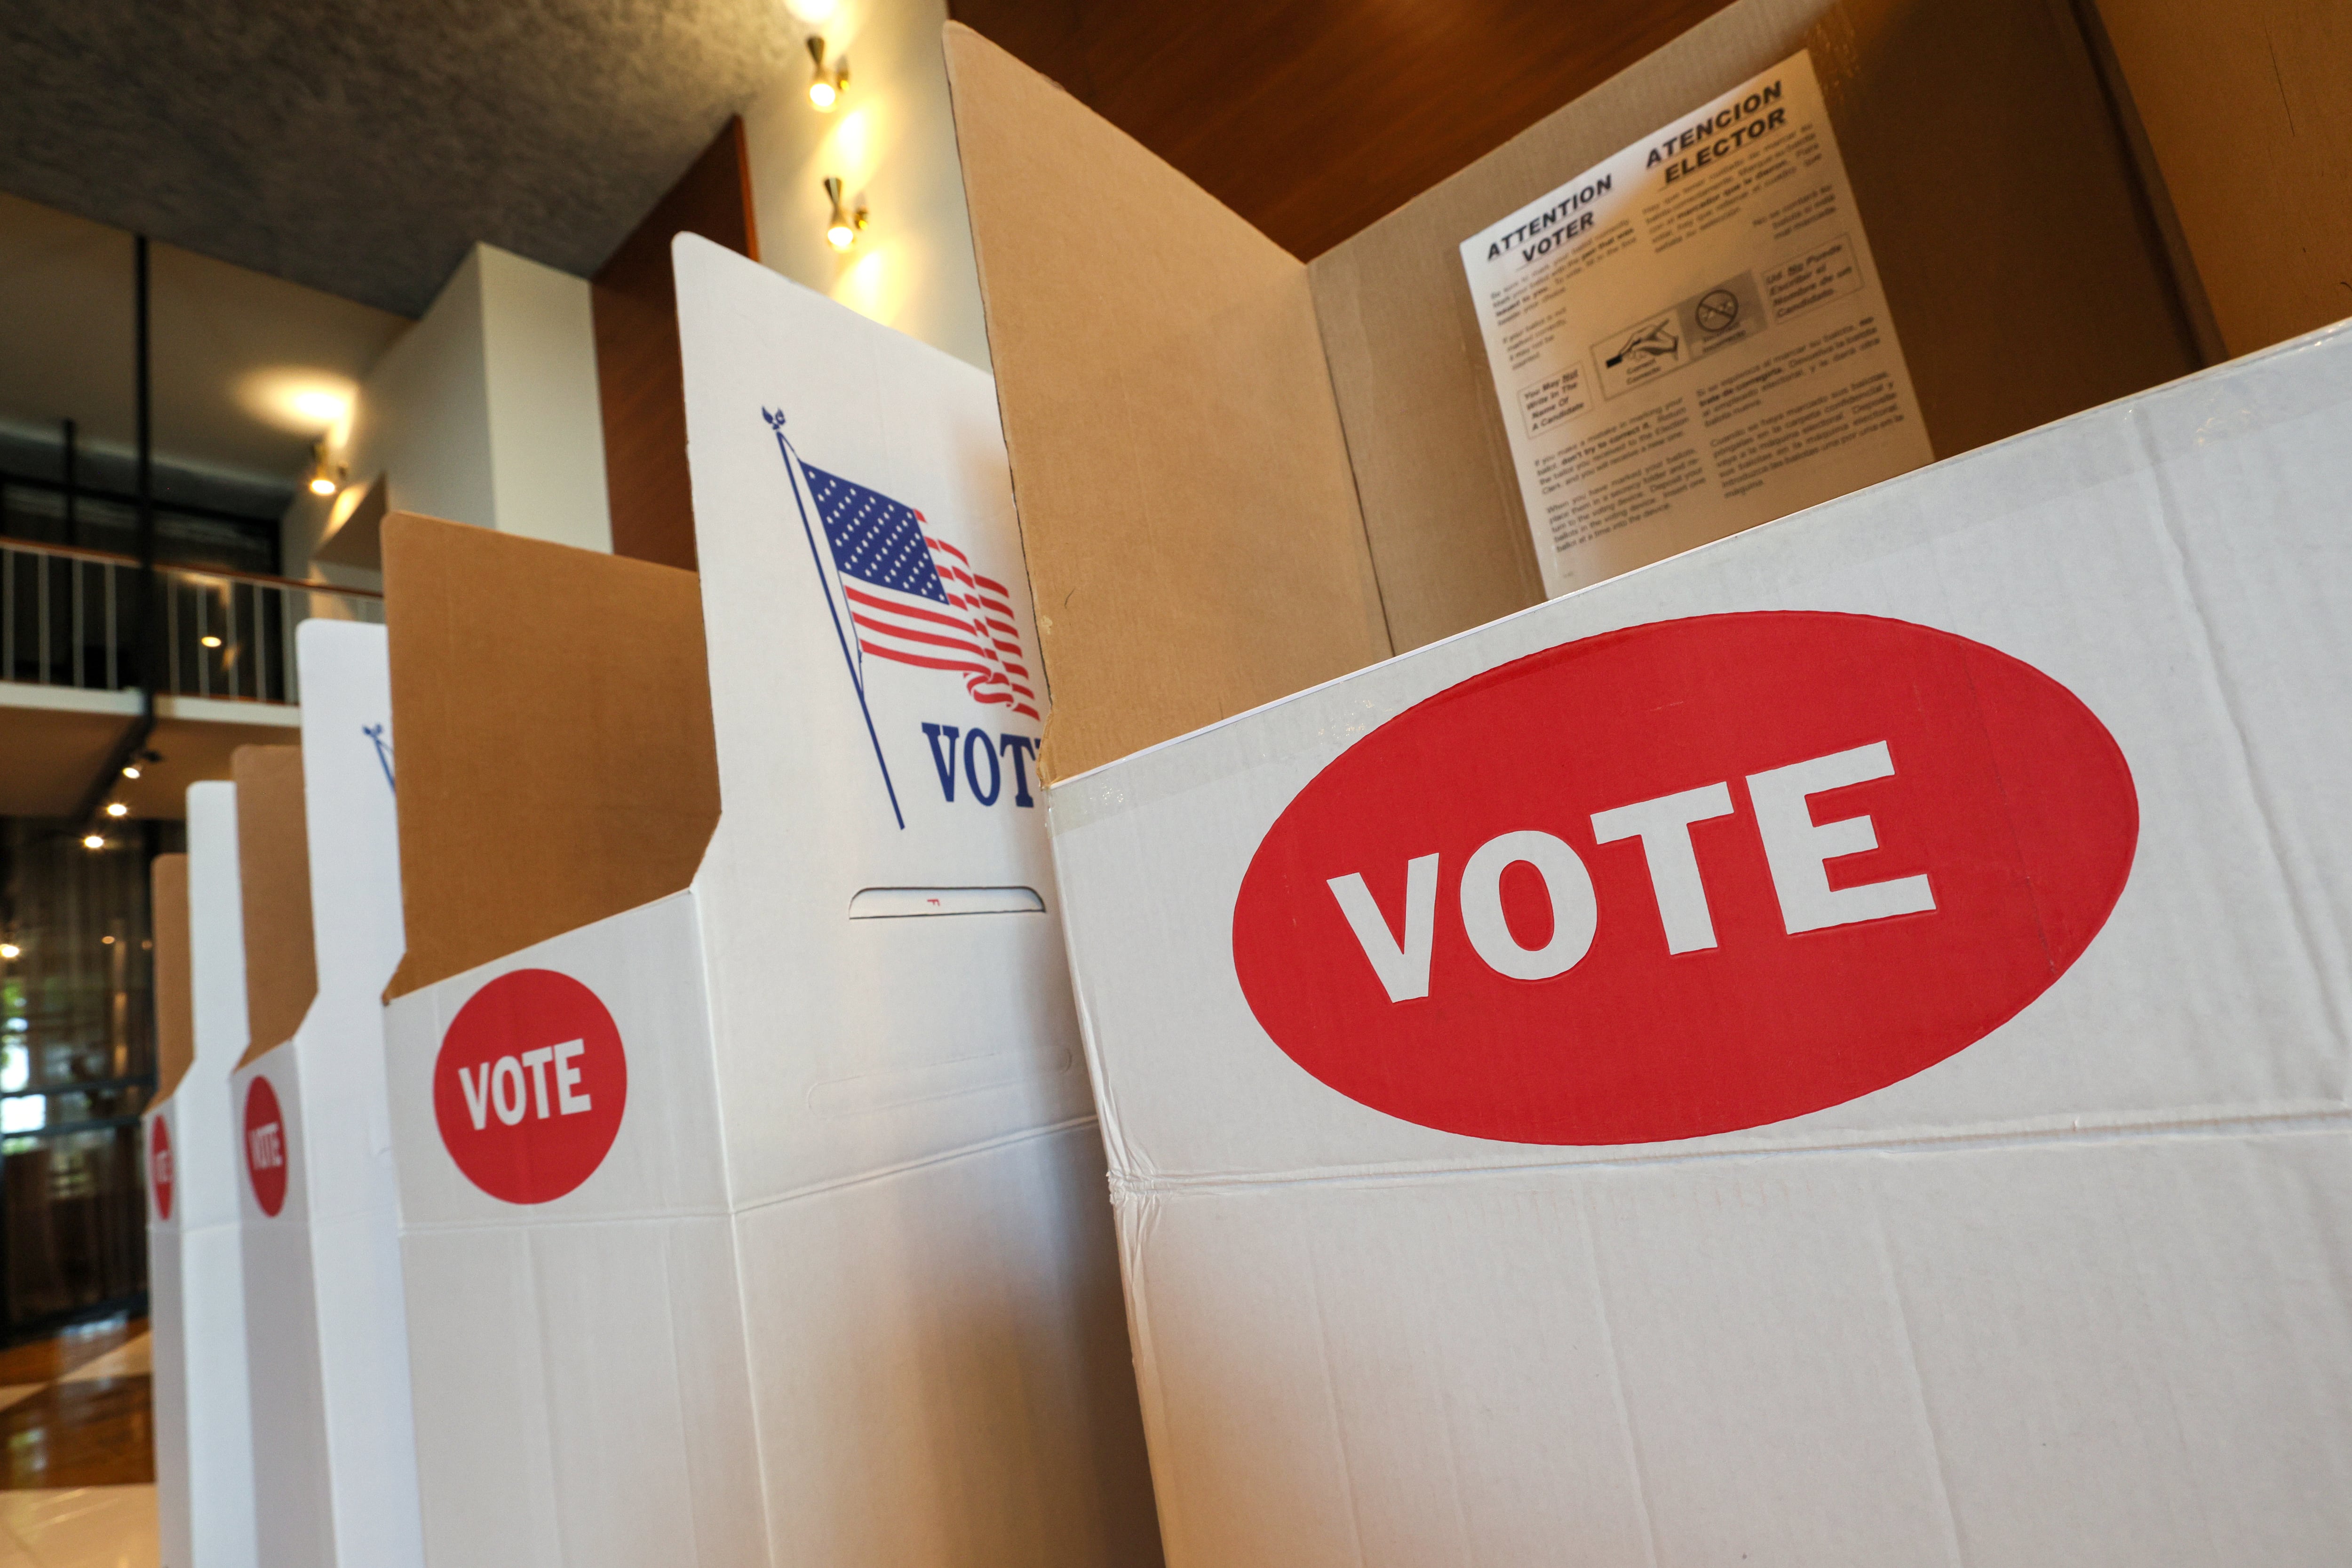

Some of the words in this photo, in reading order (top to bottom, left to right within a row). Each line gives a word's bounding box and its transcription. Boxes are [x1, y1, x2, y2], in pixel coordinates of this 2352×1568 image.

[1643, 79, 1784, 169] ATENCION
[1661, 105, 1788, 186] ELECTOR
[1484, 175, 1615, 259] ATTENTION
[1521, 211, 1596, 263] VOTER
[1524, 388, 1541, 400] You
[1541, 377, 1561, 392] May
[921, 722, 1041, 808] VOT
[1327, 740, 1937, 1003] VOTE
[459, 1039, 591, 1130] VOTE
